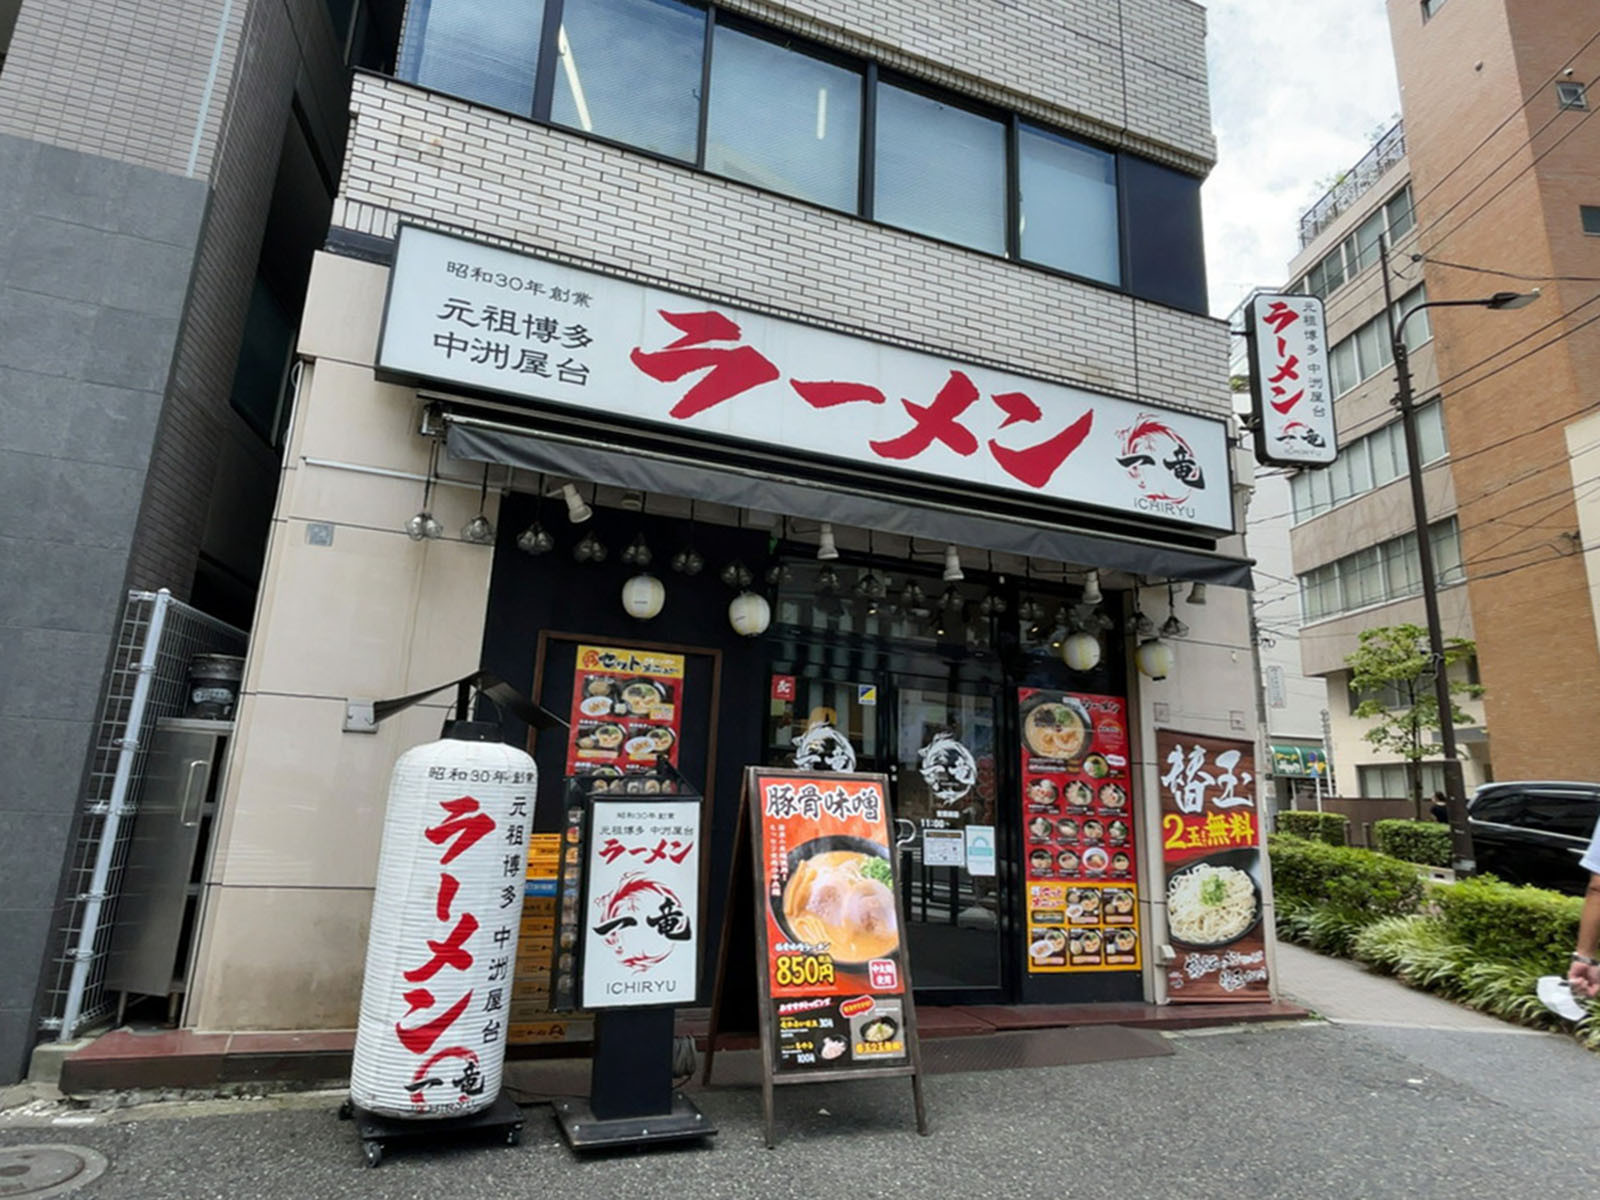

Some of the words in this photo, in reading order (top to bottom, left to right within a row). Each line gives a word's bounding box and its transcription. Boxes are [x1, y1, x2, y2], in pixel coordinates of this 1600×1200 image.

[446, 260, 594, 309] 昭和30年創業
[436, 297, 594, 350] 元祖博多
[433, 331, 591, 386] 中洲屋台
[1262, 301, 1305, 415] ラーメン
[630, 309, 1094, 488] ラーメン
[1116, 446, 1205, 490] 一竜
[1133, 497, 1196, 519] ICHIRYU
[766, 784, 881, 822] 豚骨味噌
[500, 796, 527, 909] 元祖博多
[598, 838, 694, 865] ラーメン
[395, 795, 496, 1055] ラーメン
[592, 897, 692, 941] 一竜
[482, 926, 512, 1044] 中洲屋台
[606, 980, 677, 995] ICHIRYU
[776, 955, 835, 986] 850円
[404, 1061, 486, 1096] 一竜
